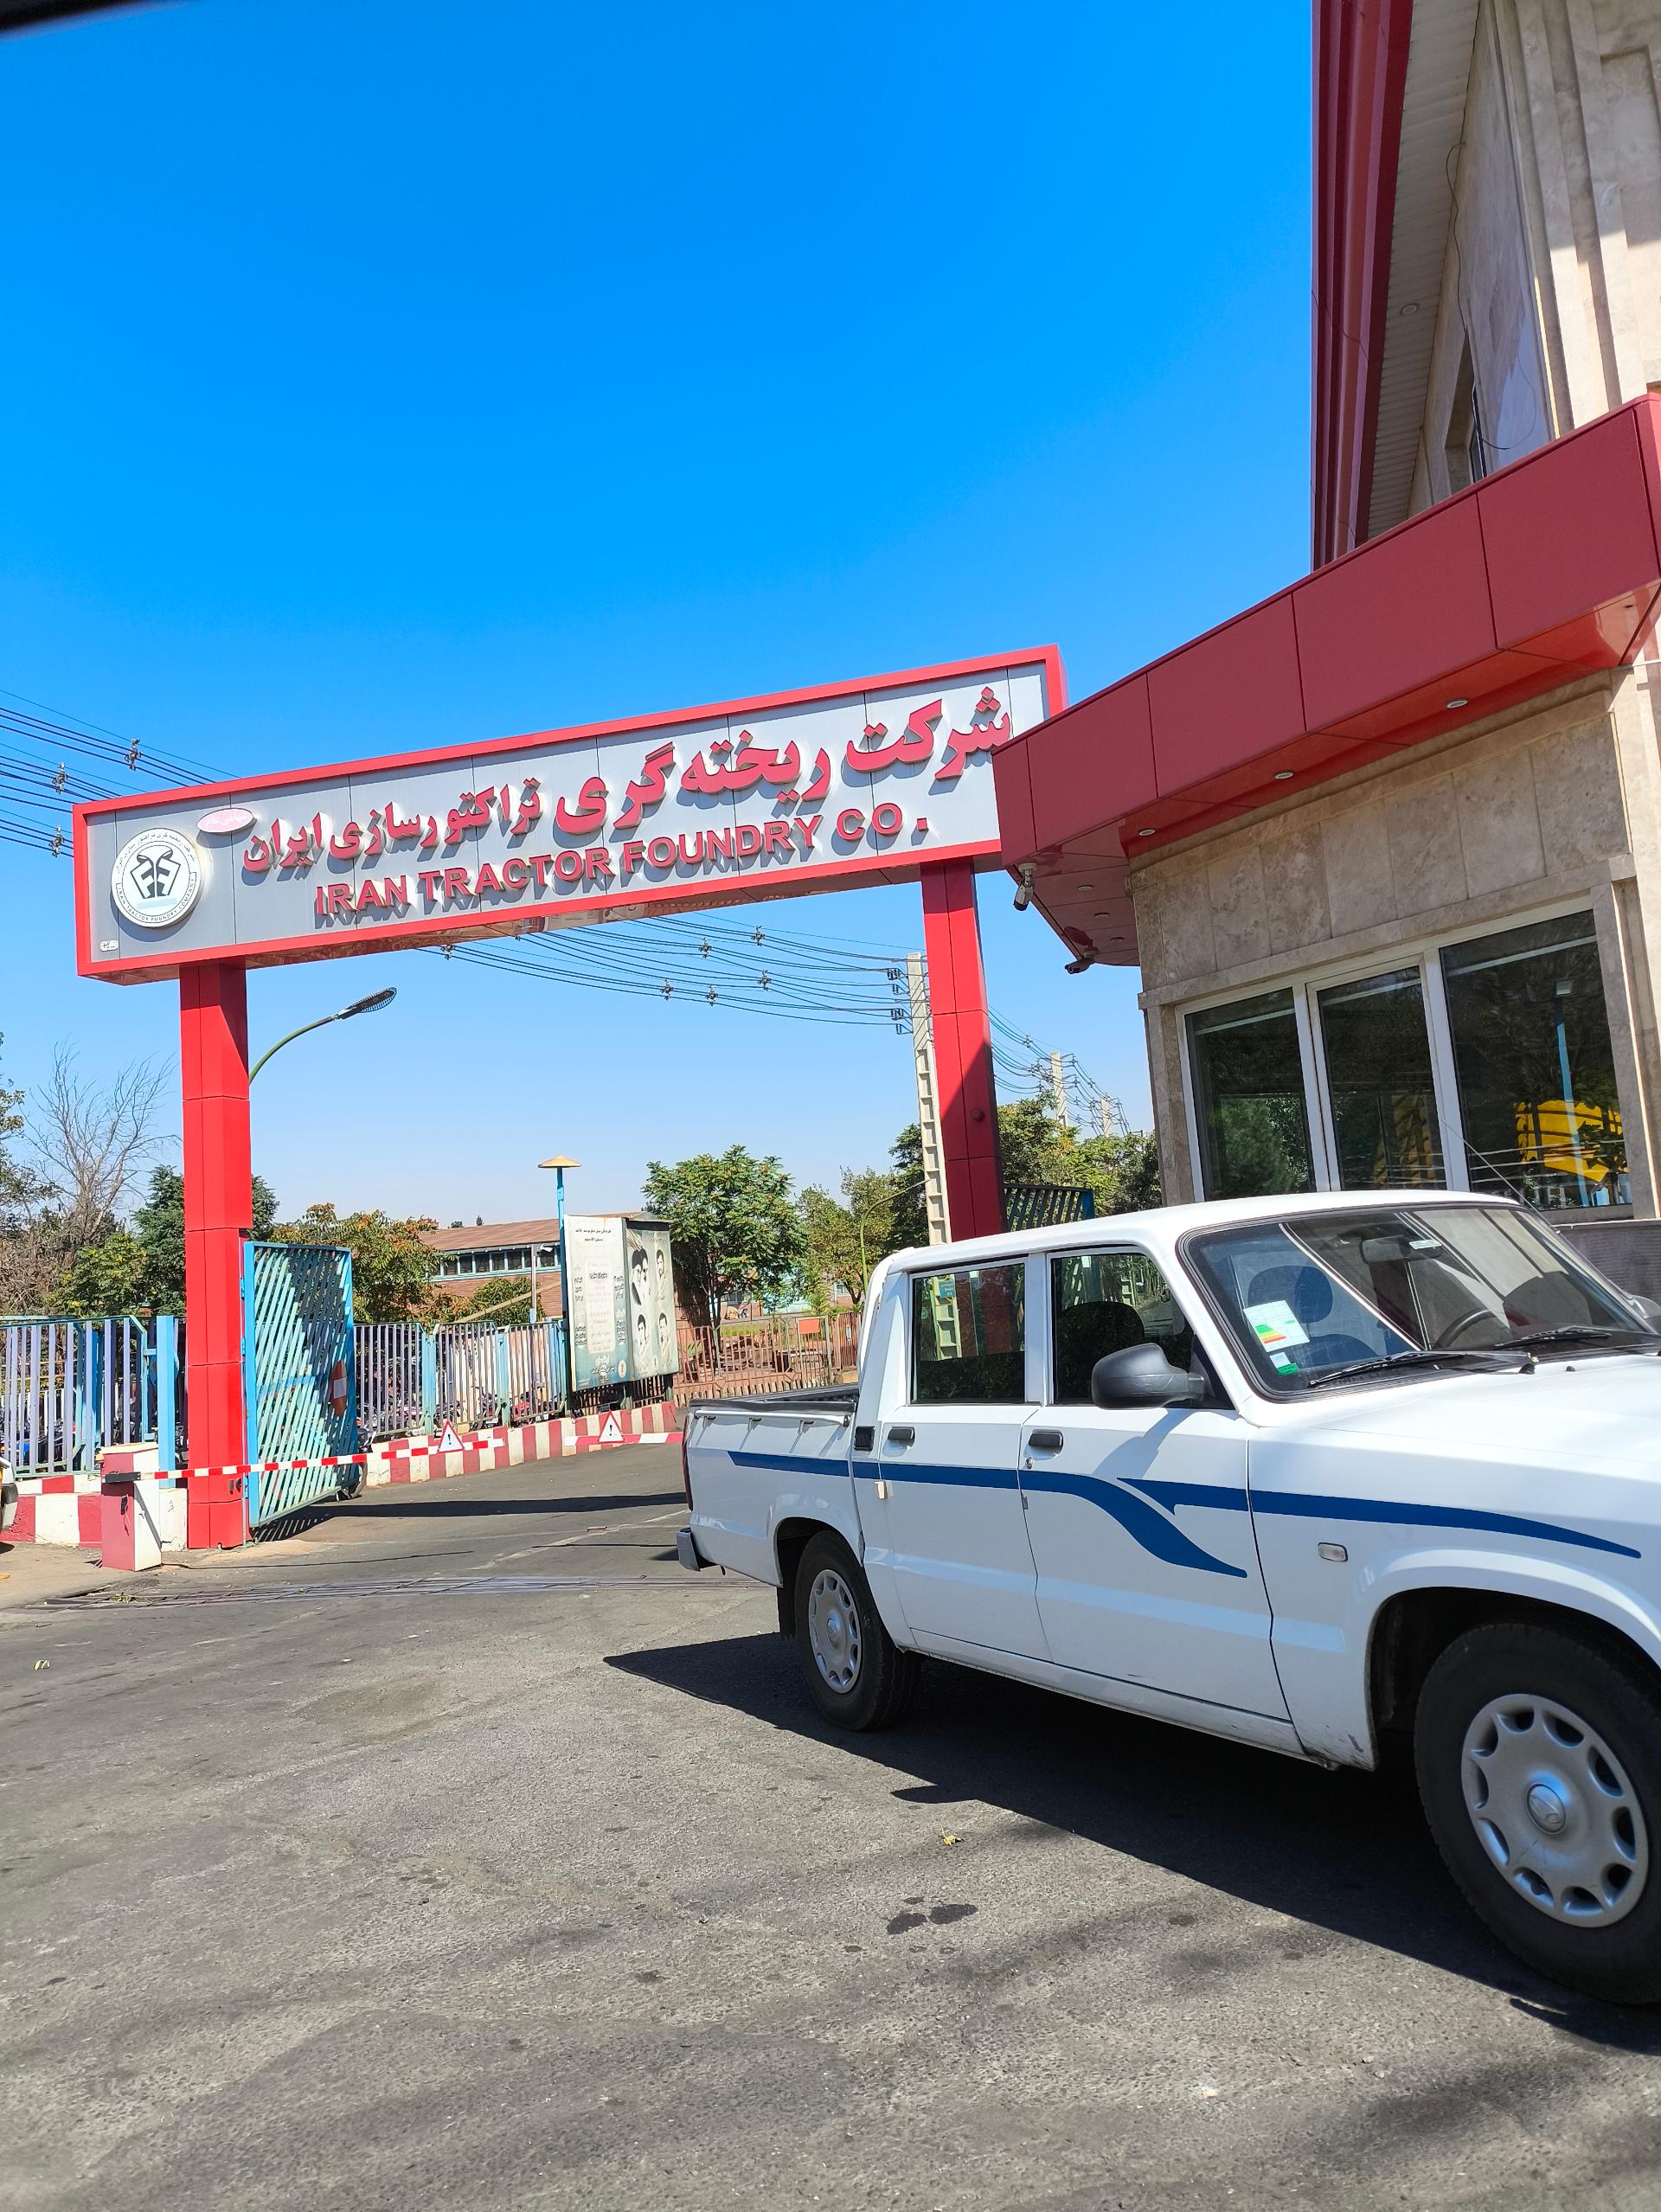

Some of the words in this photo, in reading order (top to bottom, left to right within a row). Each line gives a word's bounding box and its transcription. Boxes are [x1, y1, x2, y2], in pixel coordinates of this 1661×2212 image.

[680, 729, 832, 804] ریخته
[845, 686, 1011, 781] شرکت
[555, 741, 675, 836] گری
[243, 811, 324, 872] ایران
[316, 875, 410, 916] IRAN
[418, 847, 617, 902] TRACTOR
[623, 815, 824, 874] FOUNDRY
[126, 905, 149, 920] TRACTOR
[151, 910, 178, 921] FOUNDRY
[178, 878, 195, 909] COMPANY
